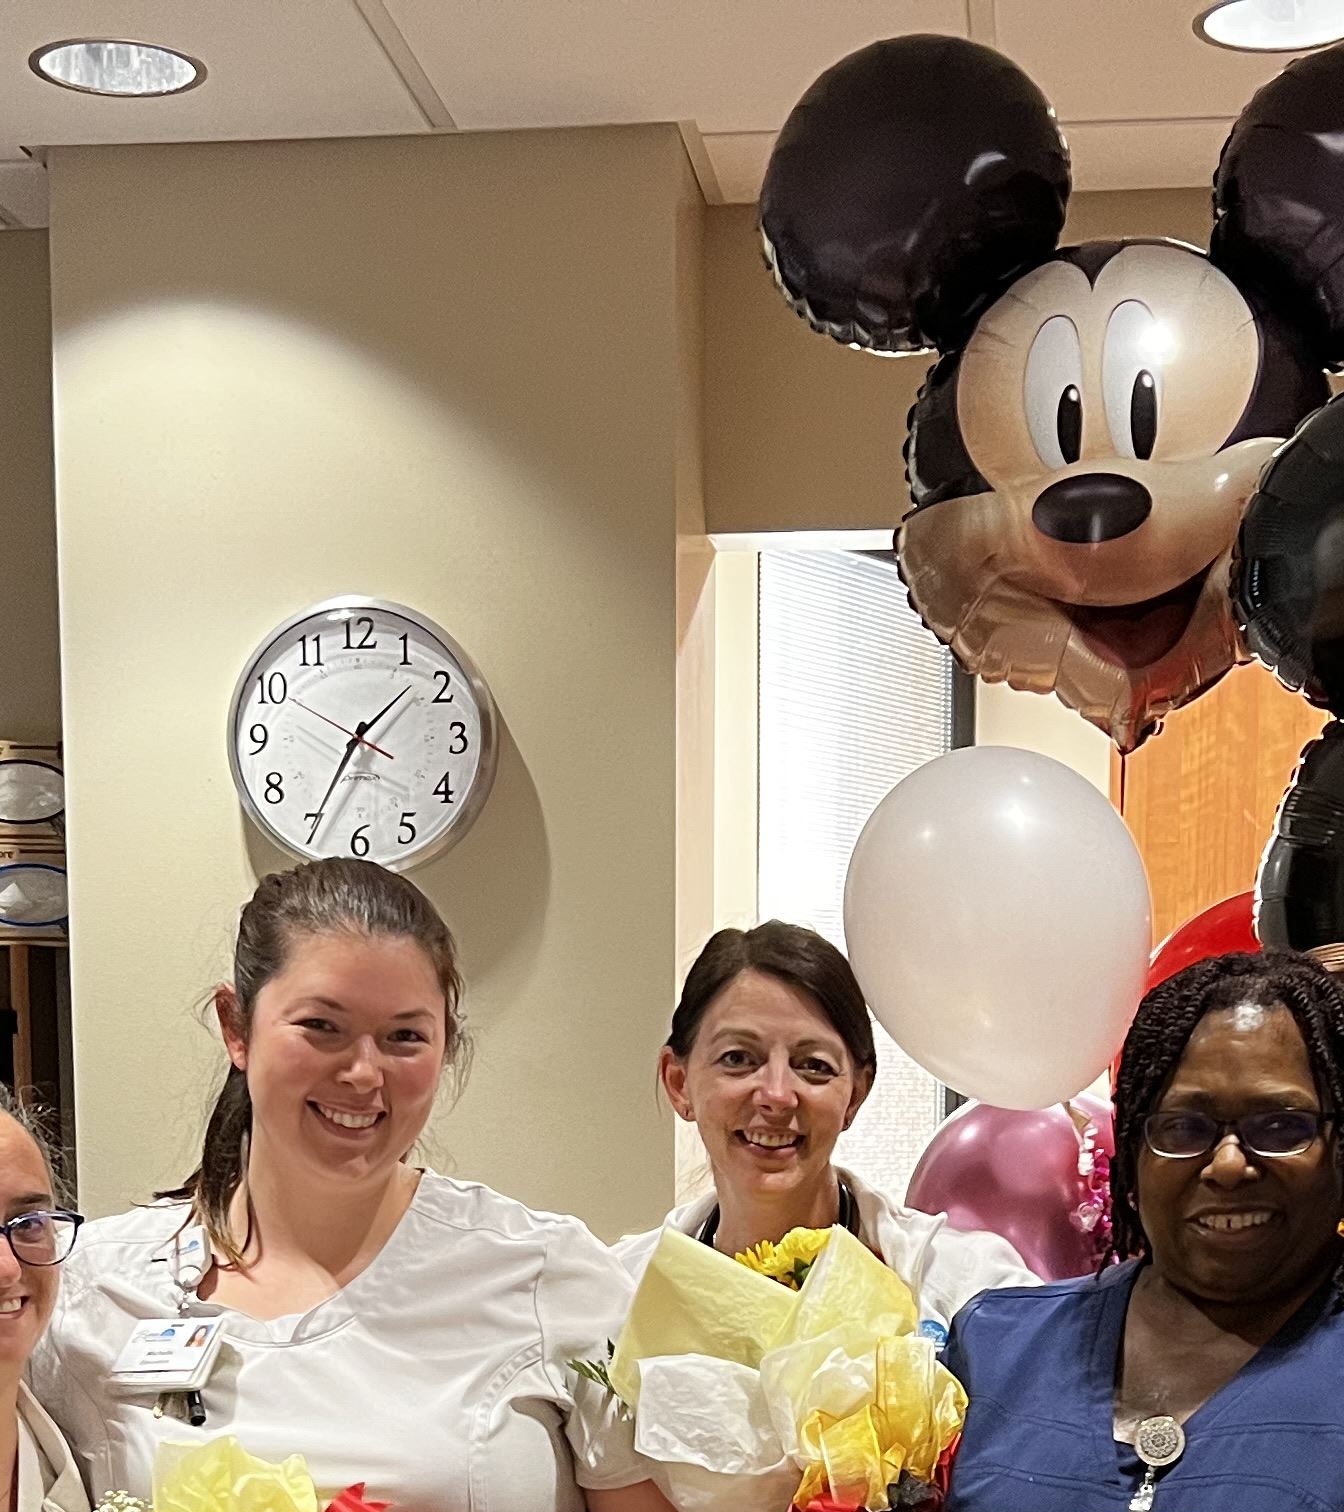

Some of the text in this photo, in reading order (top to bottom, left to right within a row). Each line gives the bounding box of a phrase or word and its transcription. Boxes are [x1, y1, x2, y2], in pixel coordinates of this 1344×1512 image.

[342, 617, 377, 650] 12
[399, 633, 413, 665] 1
[298, 634, 325, 666] 11
[258, 672, 287, 704] 10
[432, 671, 454, 703] 2
[249, 724, 268, 755] 9
[449, 722, 468, 754] 3
[264, 772, 284, 804] 8
[432, 771, 454, 803] 4
[304, 813, 324, 845] 7
[350, 824, 370, 857] 6
[397, 812, 417, 844] 5
